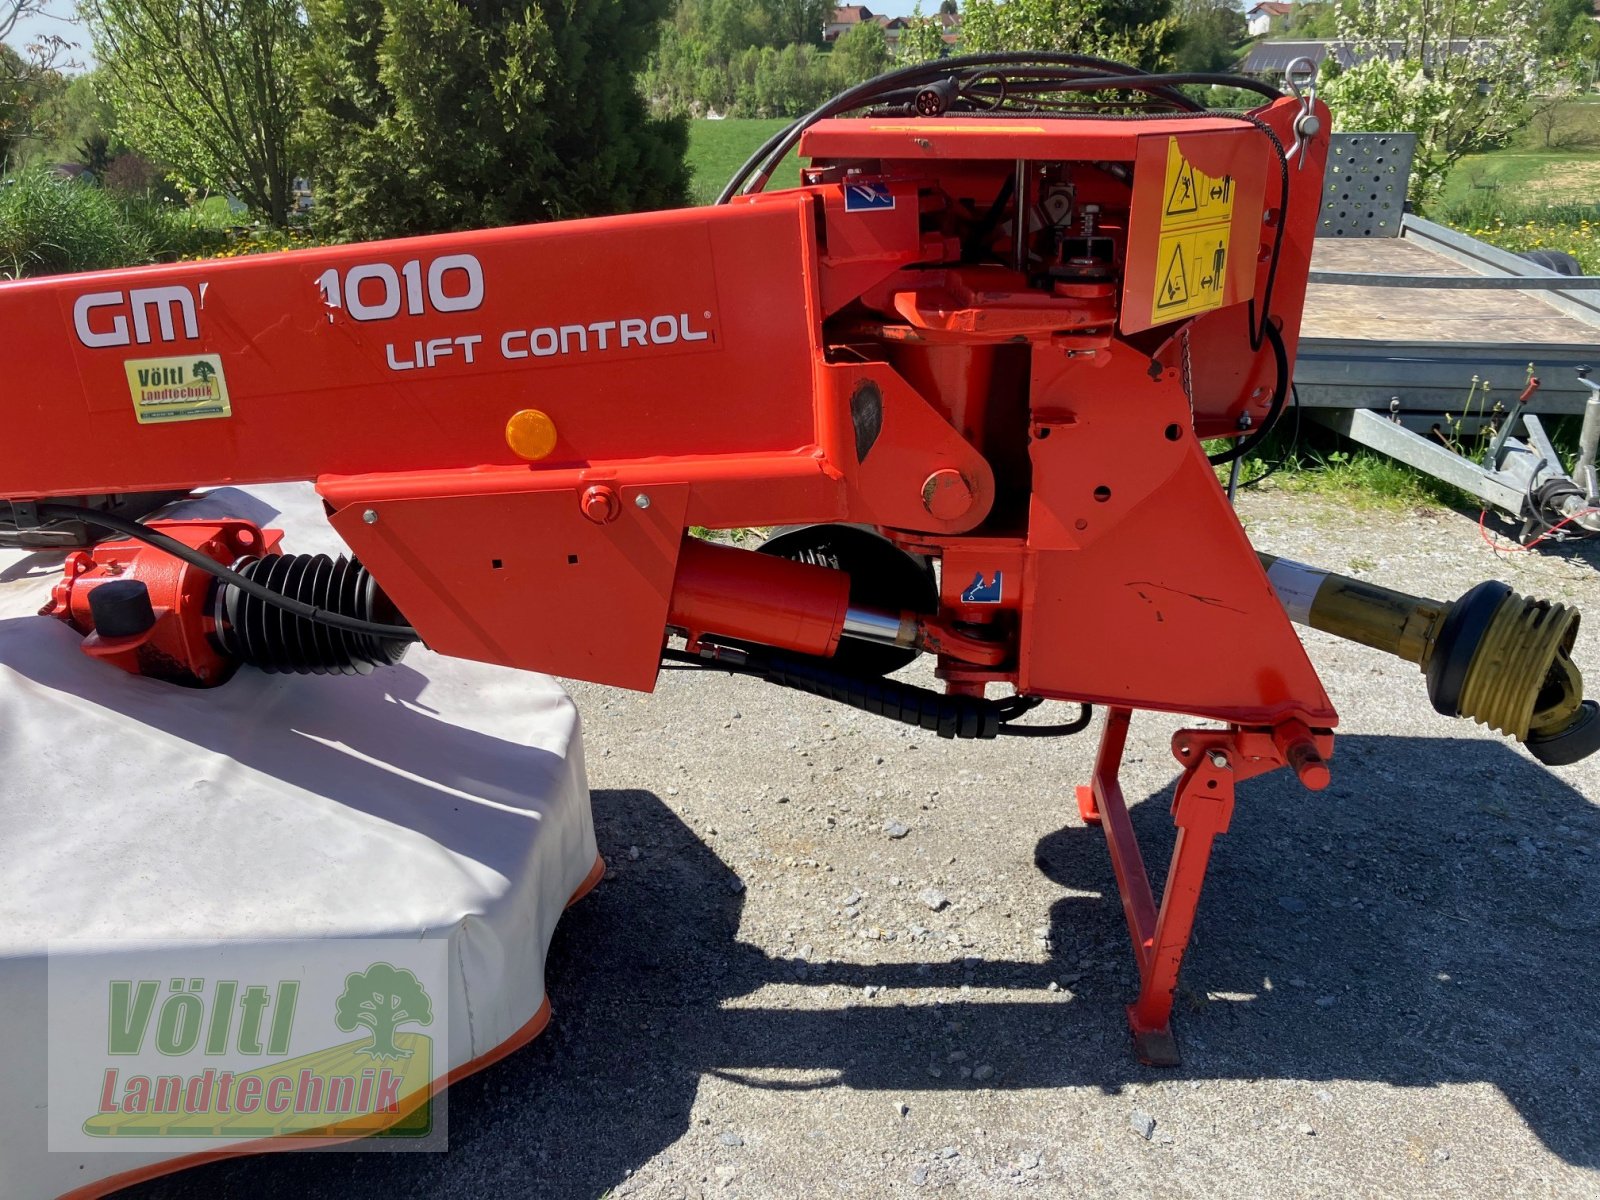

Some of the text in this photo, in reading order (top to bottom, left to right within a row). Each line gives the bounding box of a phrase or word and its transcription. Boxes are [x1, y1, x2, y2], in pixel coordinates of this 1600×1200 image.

[313, 253, 485, 324] 1010
[386, 334, 482, 371] LIFT
[138, 366, 183, 387] Völtl
[141, 385, 212, 401] Landtechnik
